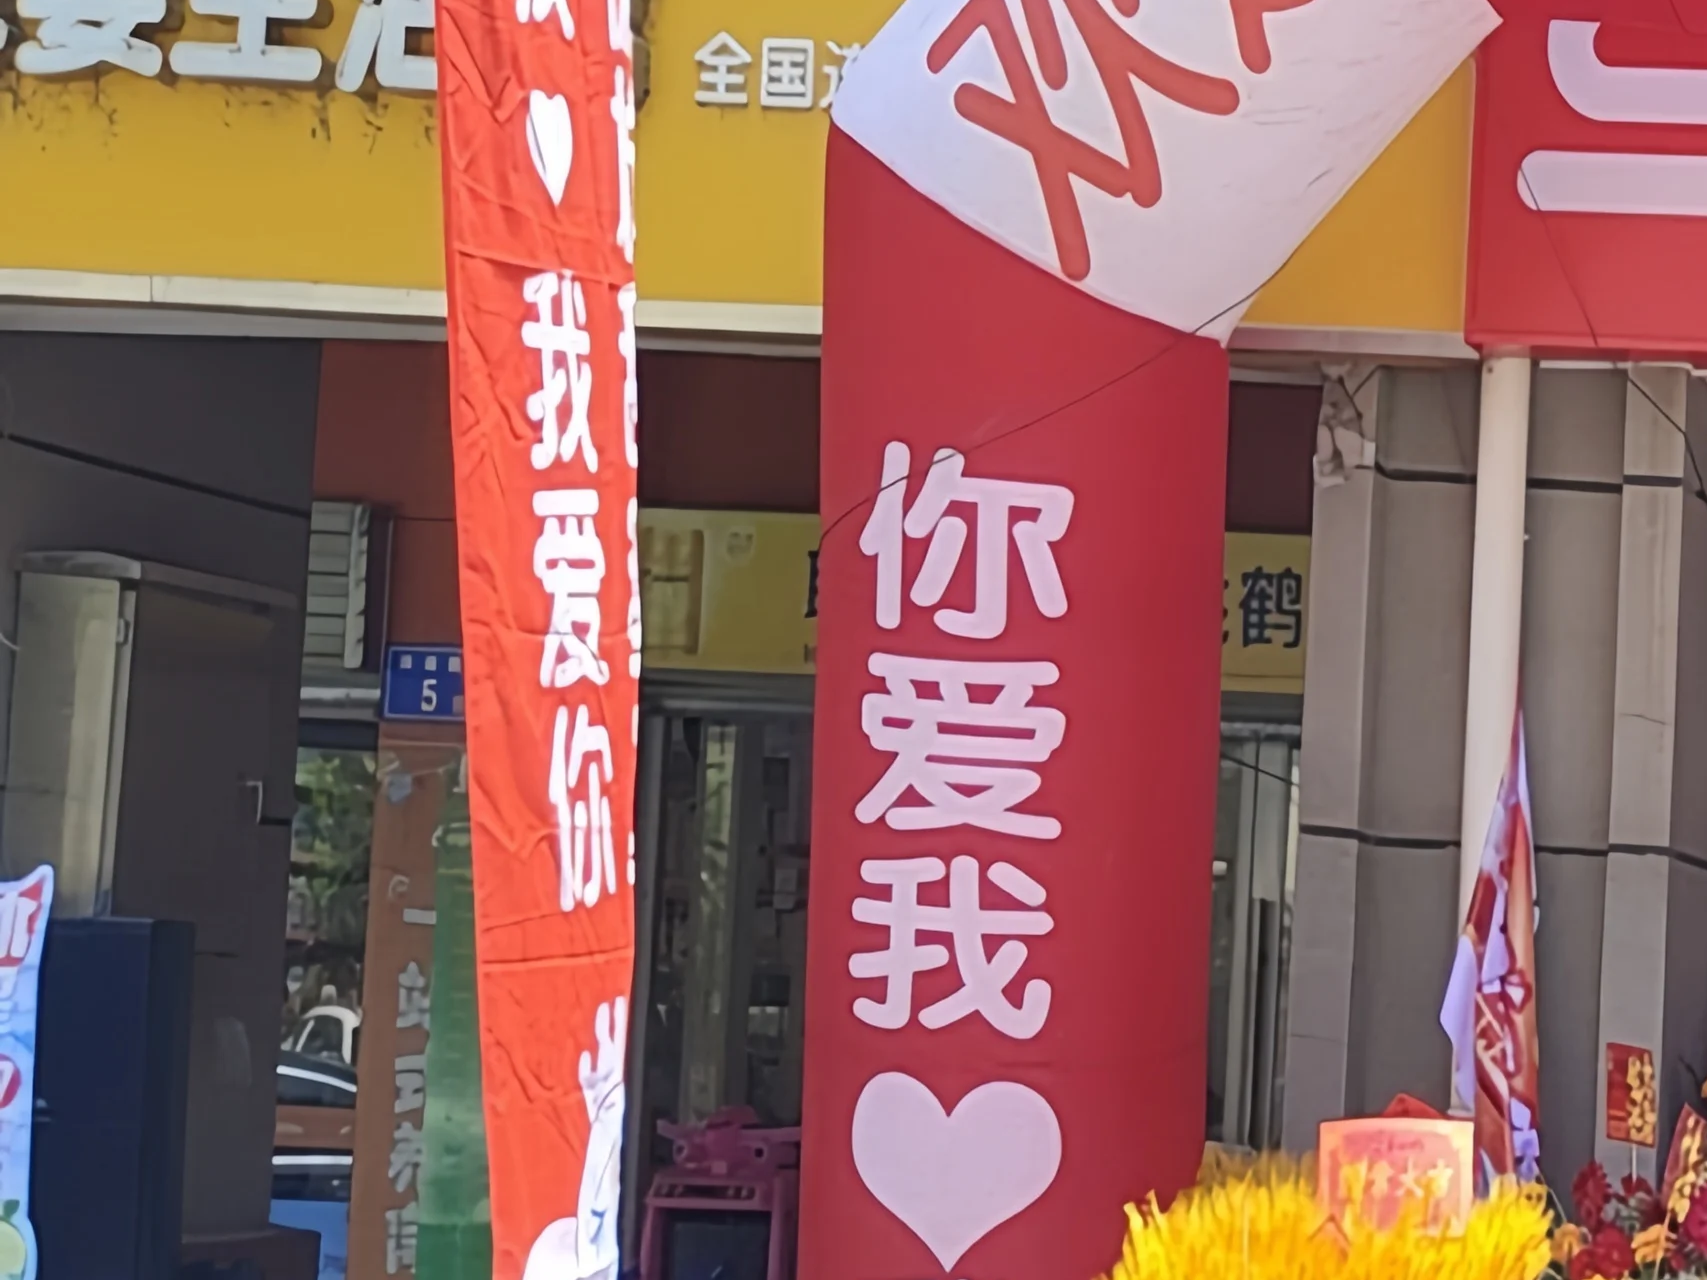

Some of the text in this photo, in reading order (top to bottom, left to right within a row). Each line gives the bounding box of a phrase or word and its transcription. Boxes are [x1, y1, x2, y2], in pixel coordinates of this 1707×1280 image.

[521, 267, 618, 914] 我爱你
[846, 439, 1076, 1042] 你爱我
